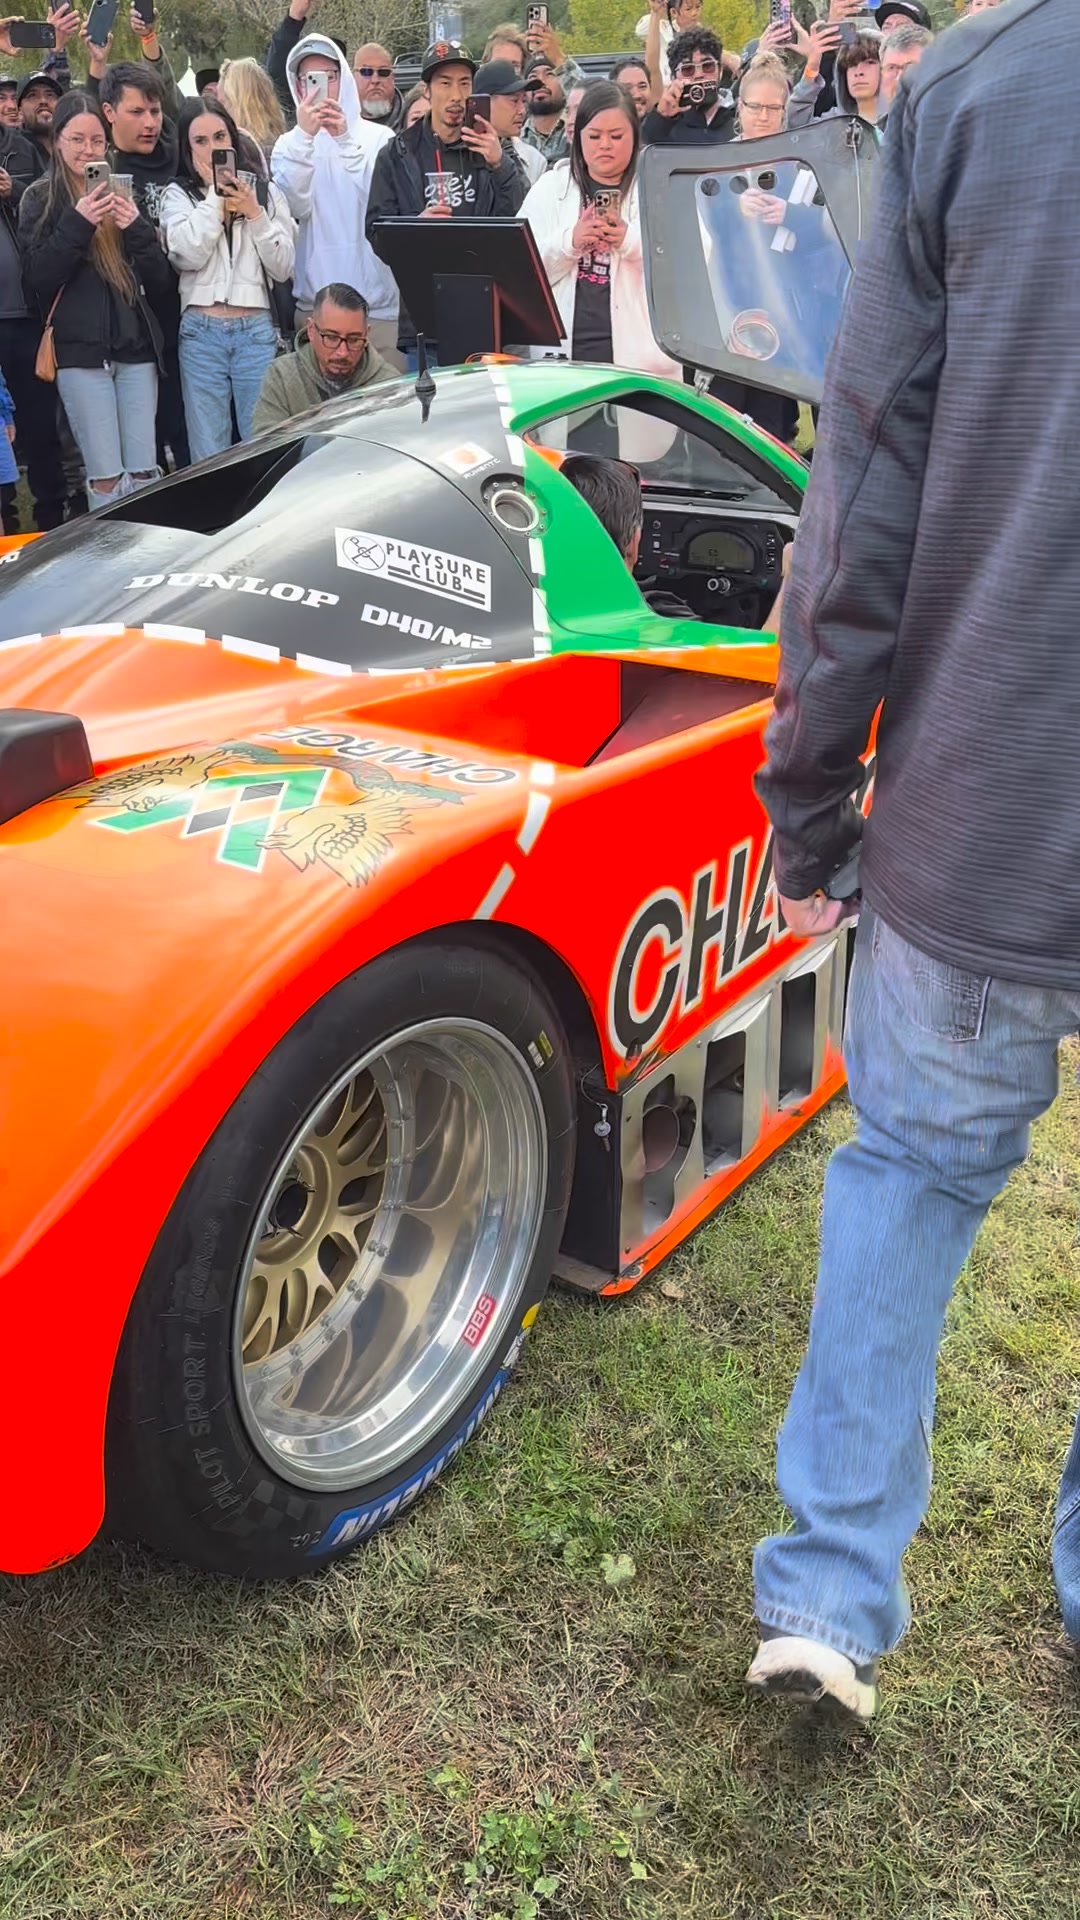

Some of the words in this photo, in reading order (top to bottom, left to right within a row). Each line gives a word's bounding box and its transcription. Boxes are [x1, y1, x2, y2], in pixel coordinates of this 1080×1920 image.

[386, 542, 486, 584] PLAYSURE
[411, 563, 463, 591] CLUB
[123, 571, 340, 608] DUNLOP
[360, 603, 493, 650] D40/M2
[259, 725, 517, 784] CHARGE
[608, 822, 791, 1055] CHA
[463, 1295, 493, 1345] BBS
[183, 1333, 211, 1437] SPORT
[193, 1447, 242, 1510] PILOT
